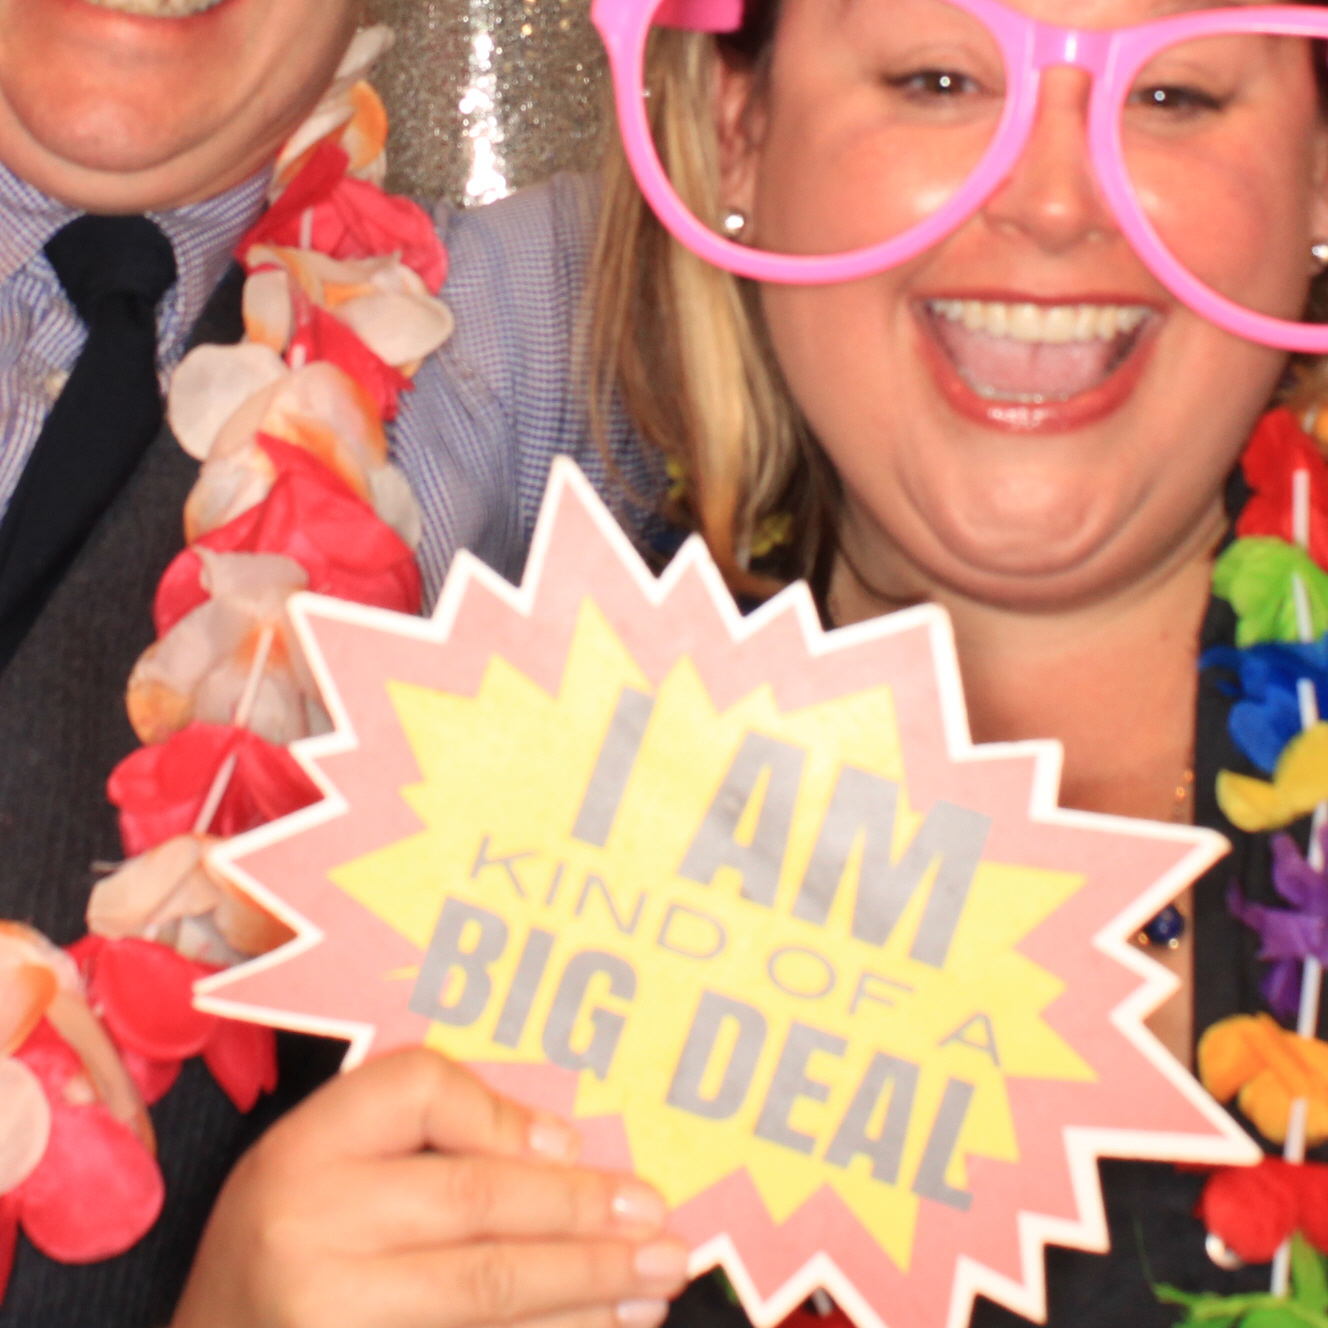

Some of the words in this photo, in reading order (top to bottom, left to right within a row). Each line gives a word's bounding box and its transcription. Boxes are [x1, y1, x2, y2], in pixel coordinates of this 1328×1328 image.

[470, 836, 728, 960] KIND
[766, 947, 915, 1015] OF
[938, 1012, 1001, 1066] A
[574, 687, 655, 848] I
[680, 732, 992, 968] AM
[410, 896, 638, 1080] BIG
[666, 990, 974, 1212] DEAL
